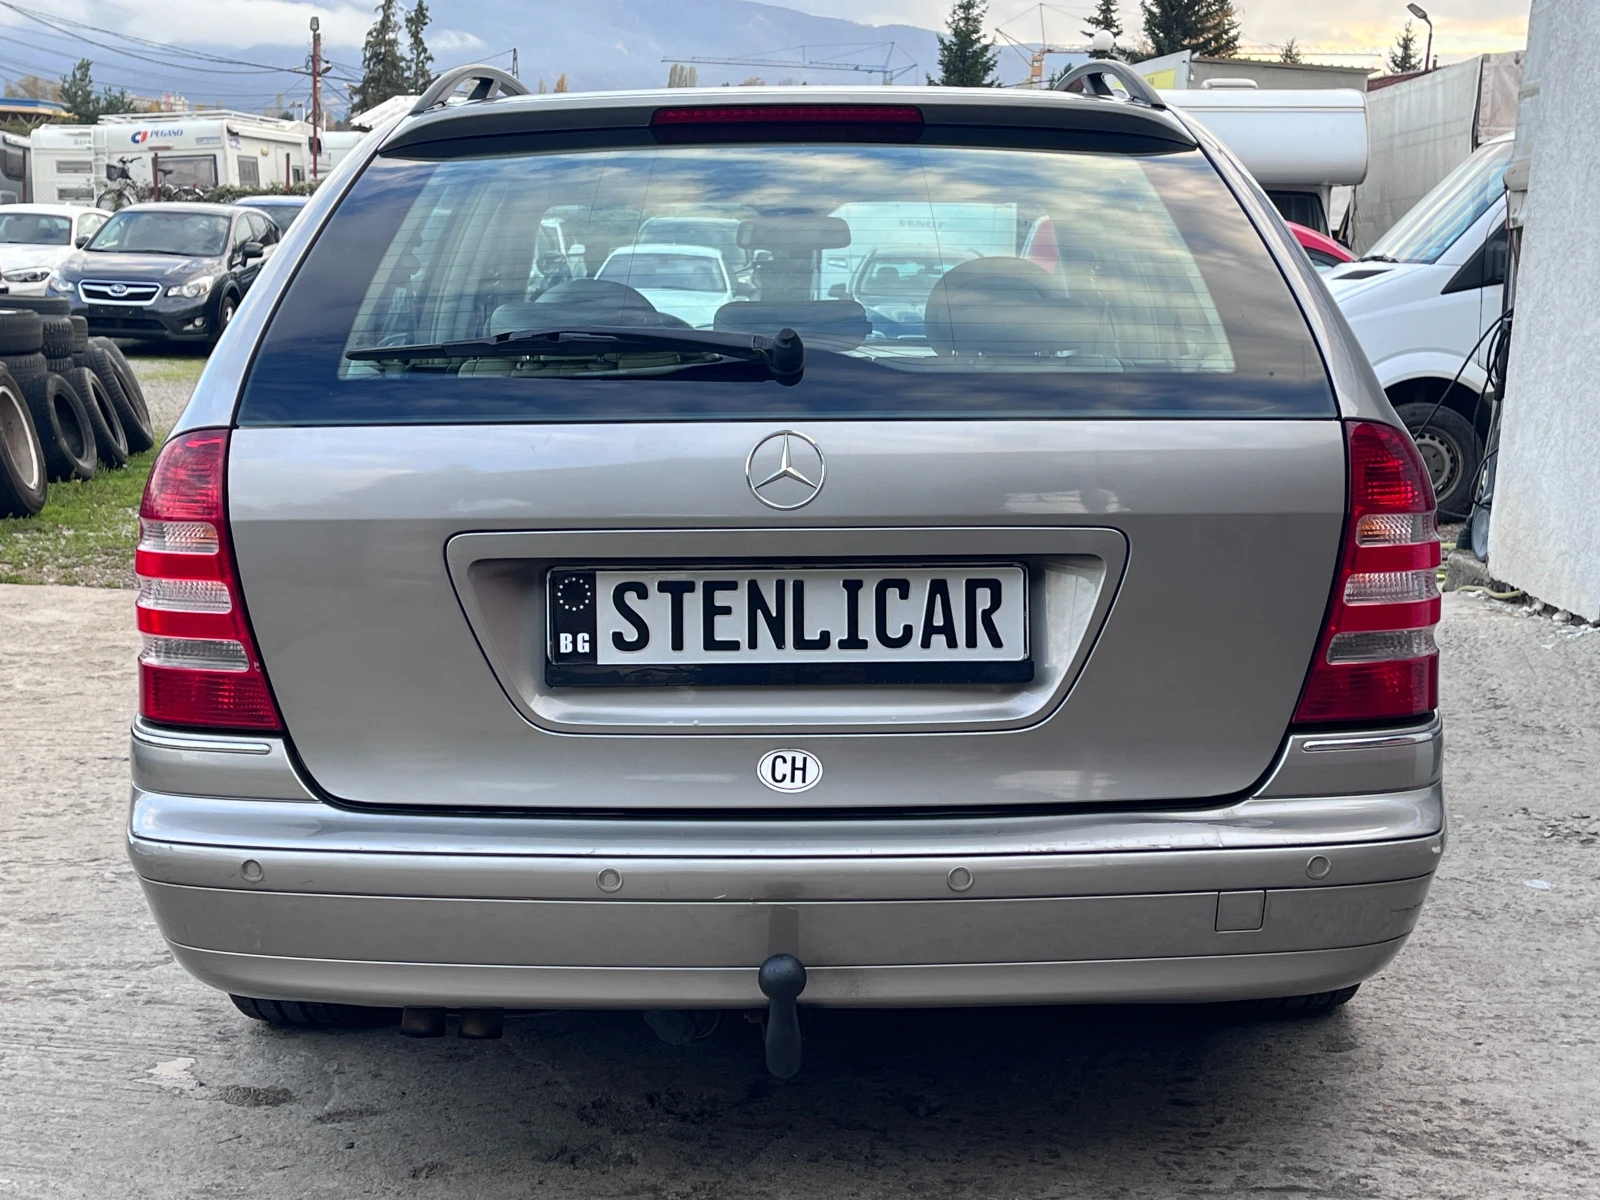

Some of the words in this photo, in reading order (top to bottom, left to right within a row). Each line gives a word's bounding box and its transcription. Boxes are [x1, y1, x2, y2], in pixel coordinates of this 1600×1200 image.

[150, 129, 183, 138] PEGASO
[611, 577, 1004, 653] STENLICAR
[559, 632, 590, 653] BG
[770, 754, 808, 784] CH
